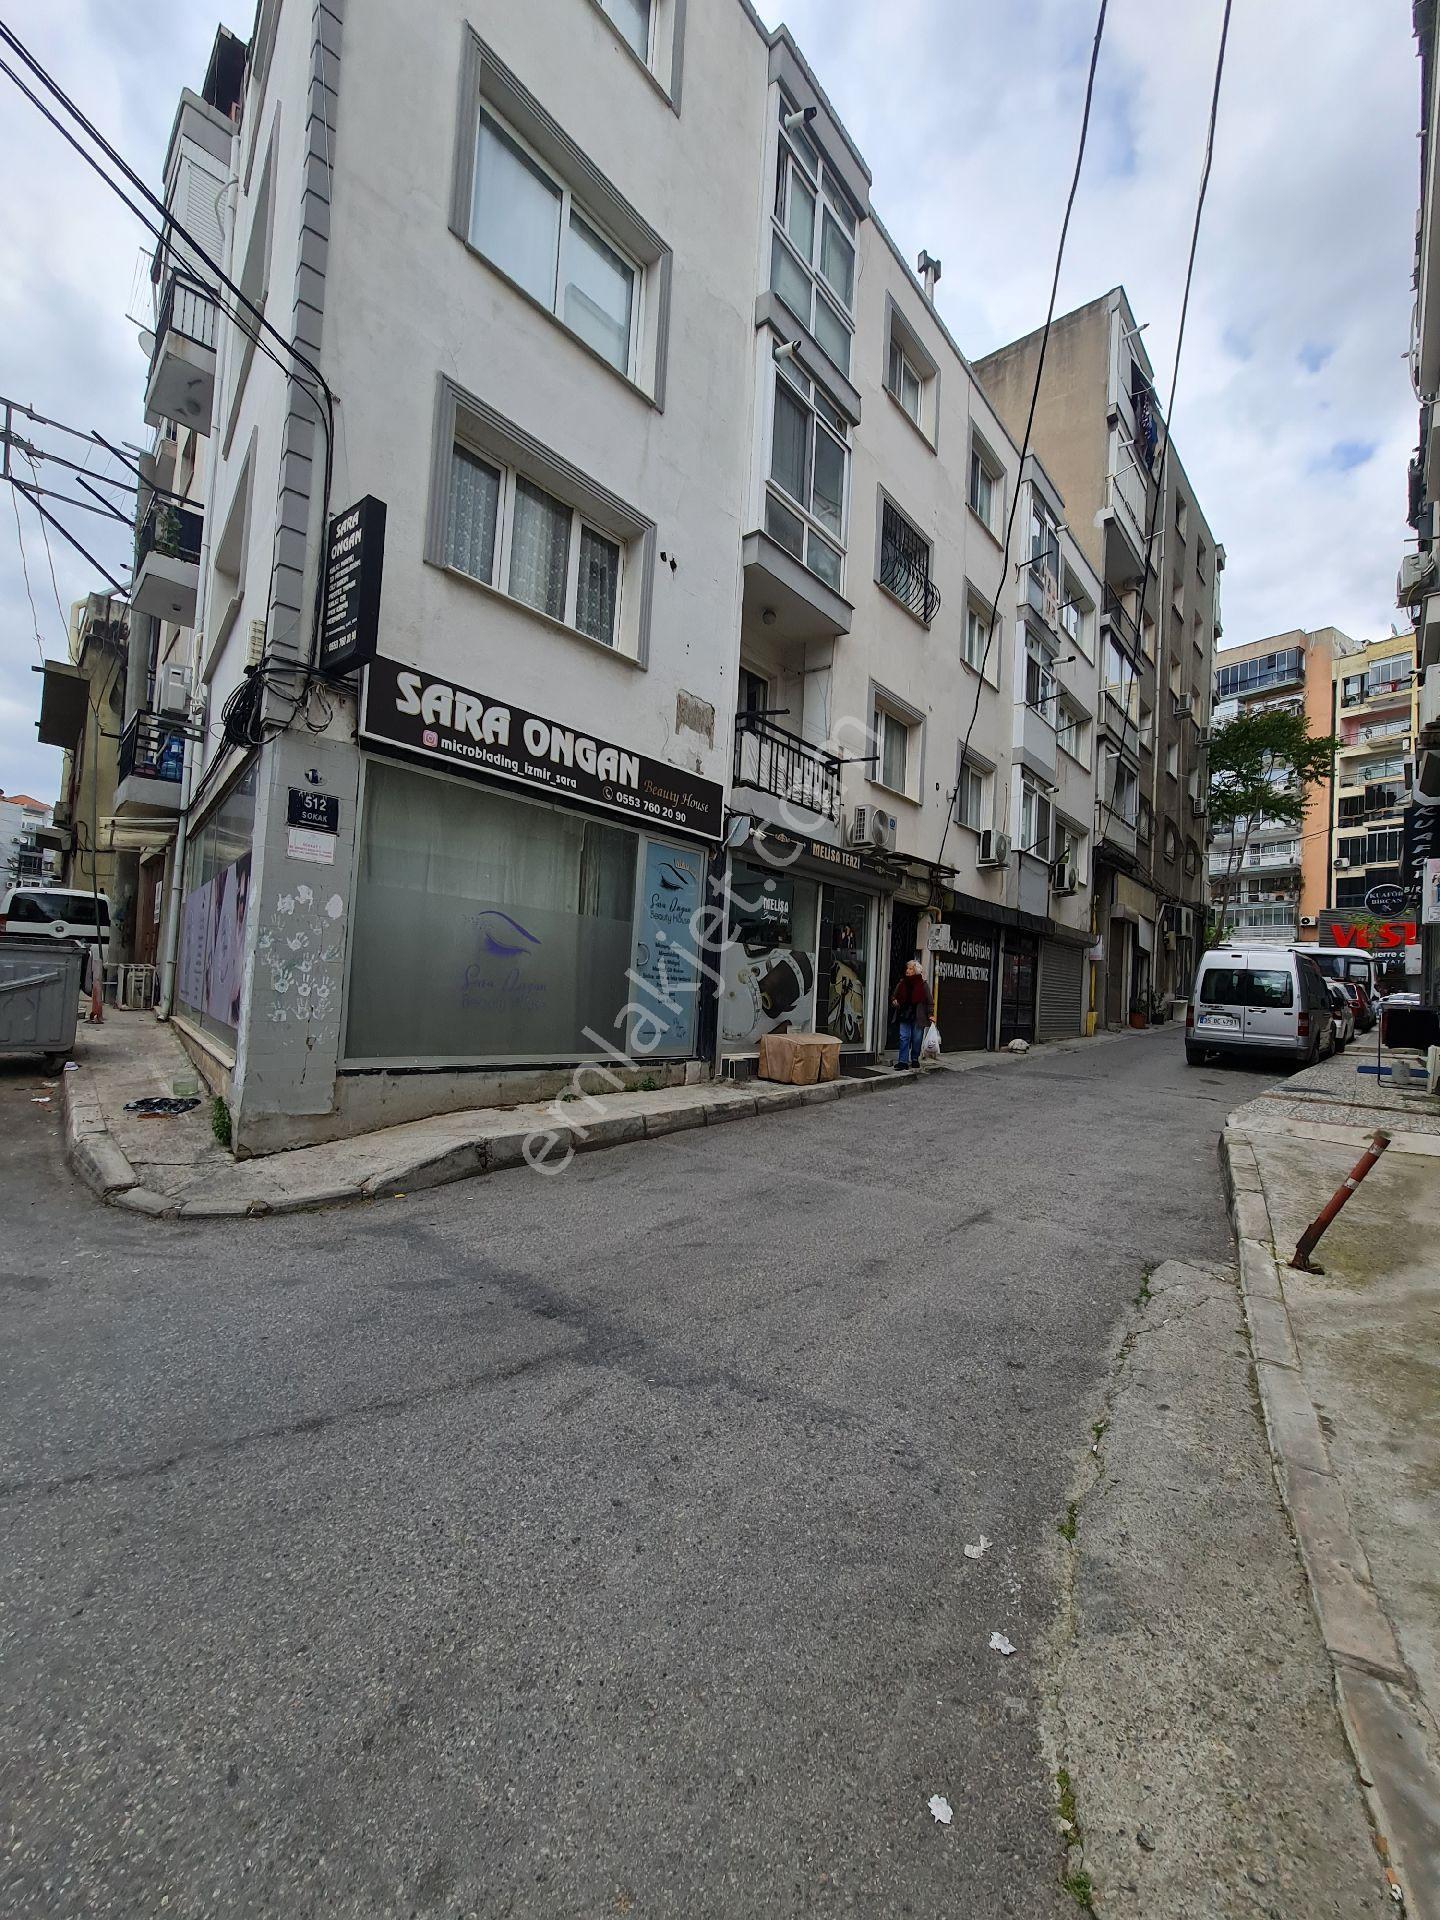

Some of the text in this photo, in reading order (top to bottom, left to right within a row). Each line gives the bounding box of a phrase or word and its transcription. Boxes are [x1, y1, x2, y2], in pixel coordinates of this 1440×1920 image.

[335, 510, 360, 539] SARA
[331, 527, 362, 560] ONGAN
[395, 671, 710, 813] SARA ONGAN Beauty House
[301, 811, 329, 823] SOKAK
[303, 795, 328, 812] 512
[616, 791, 687, 823] 0553 760 20 90
[812, 842, 861, 870] MELİSA TERZİ
